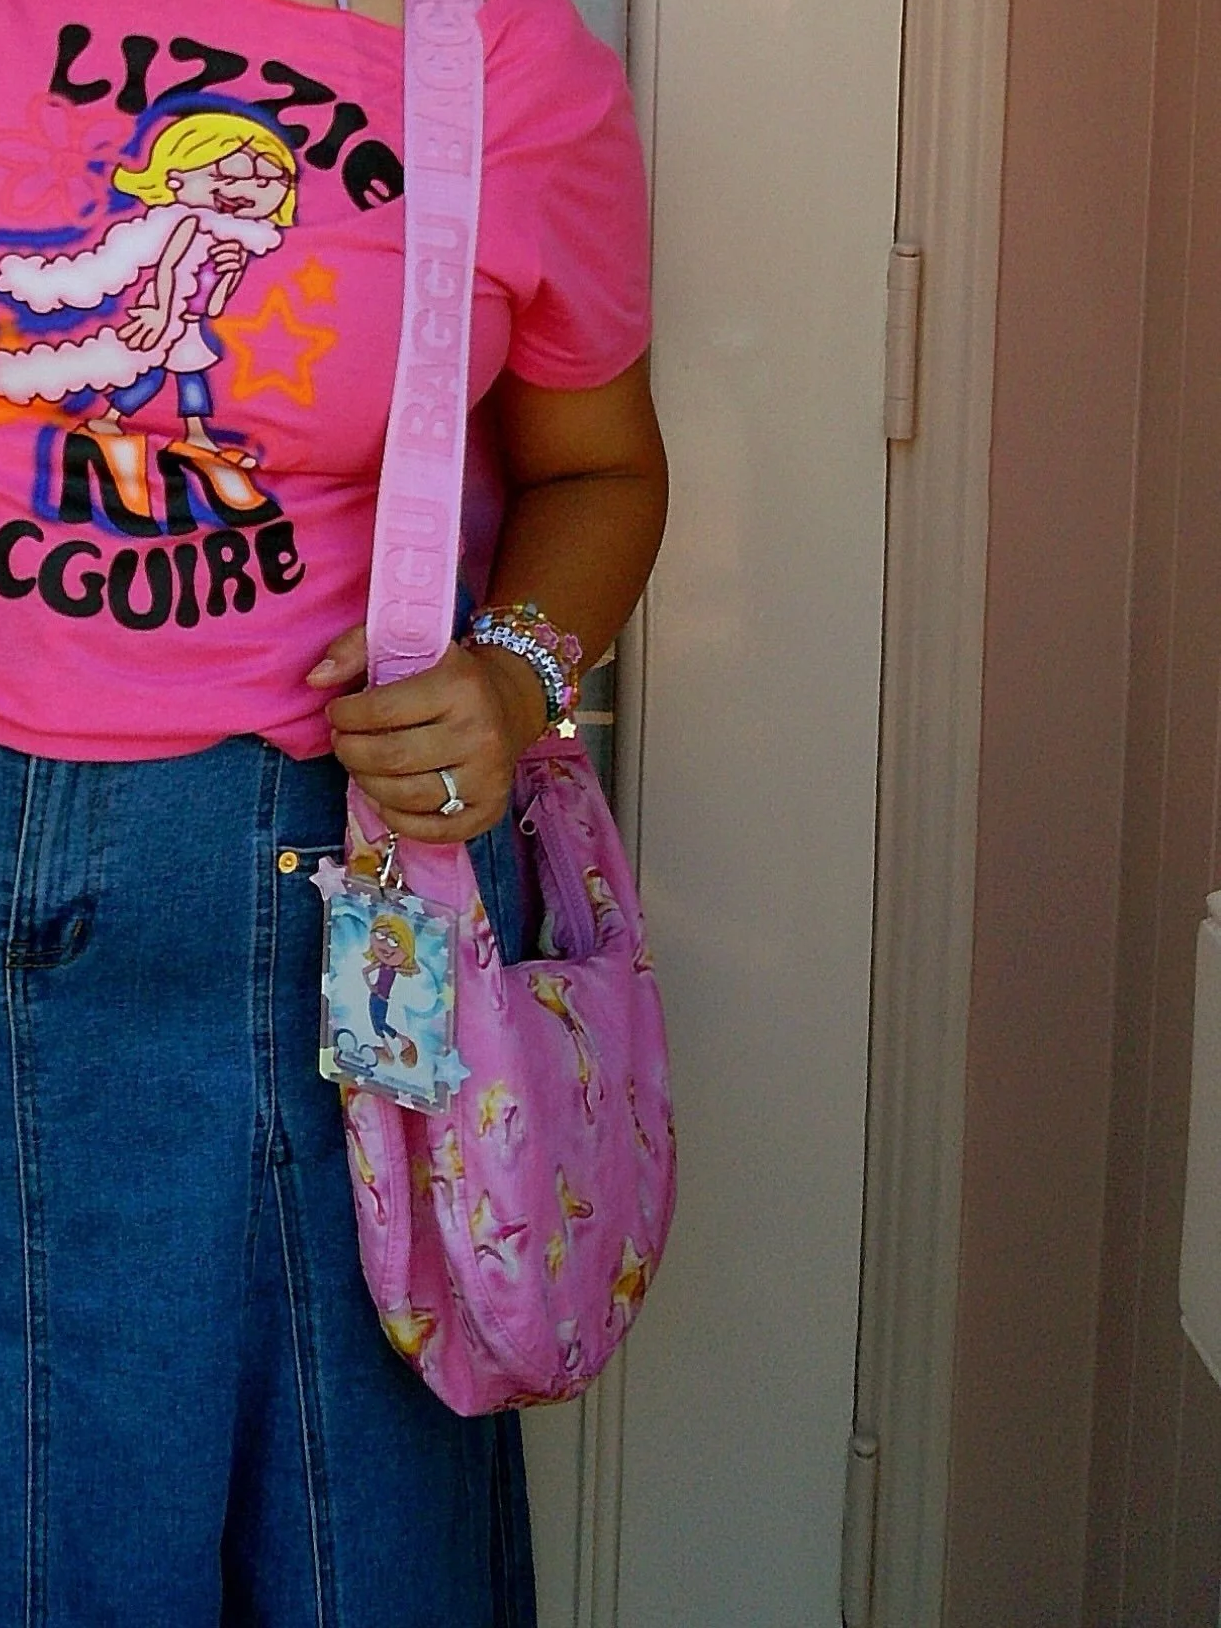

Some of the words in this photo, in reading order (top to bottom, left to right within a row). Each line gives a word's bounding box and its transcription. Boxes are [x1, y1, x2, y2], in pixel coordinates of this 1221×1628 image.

[49, 24, 404, 212] LIZZIE
[398, 216, 469, 456] BAGGU
[379, 498, 448, 655] GGU
